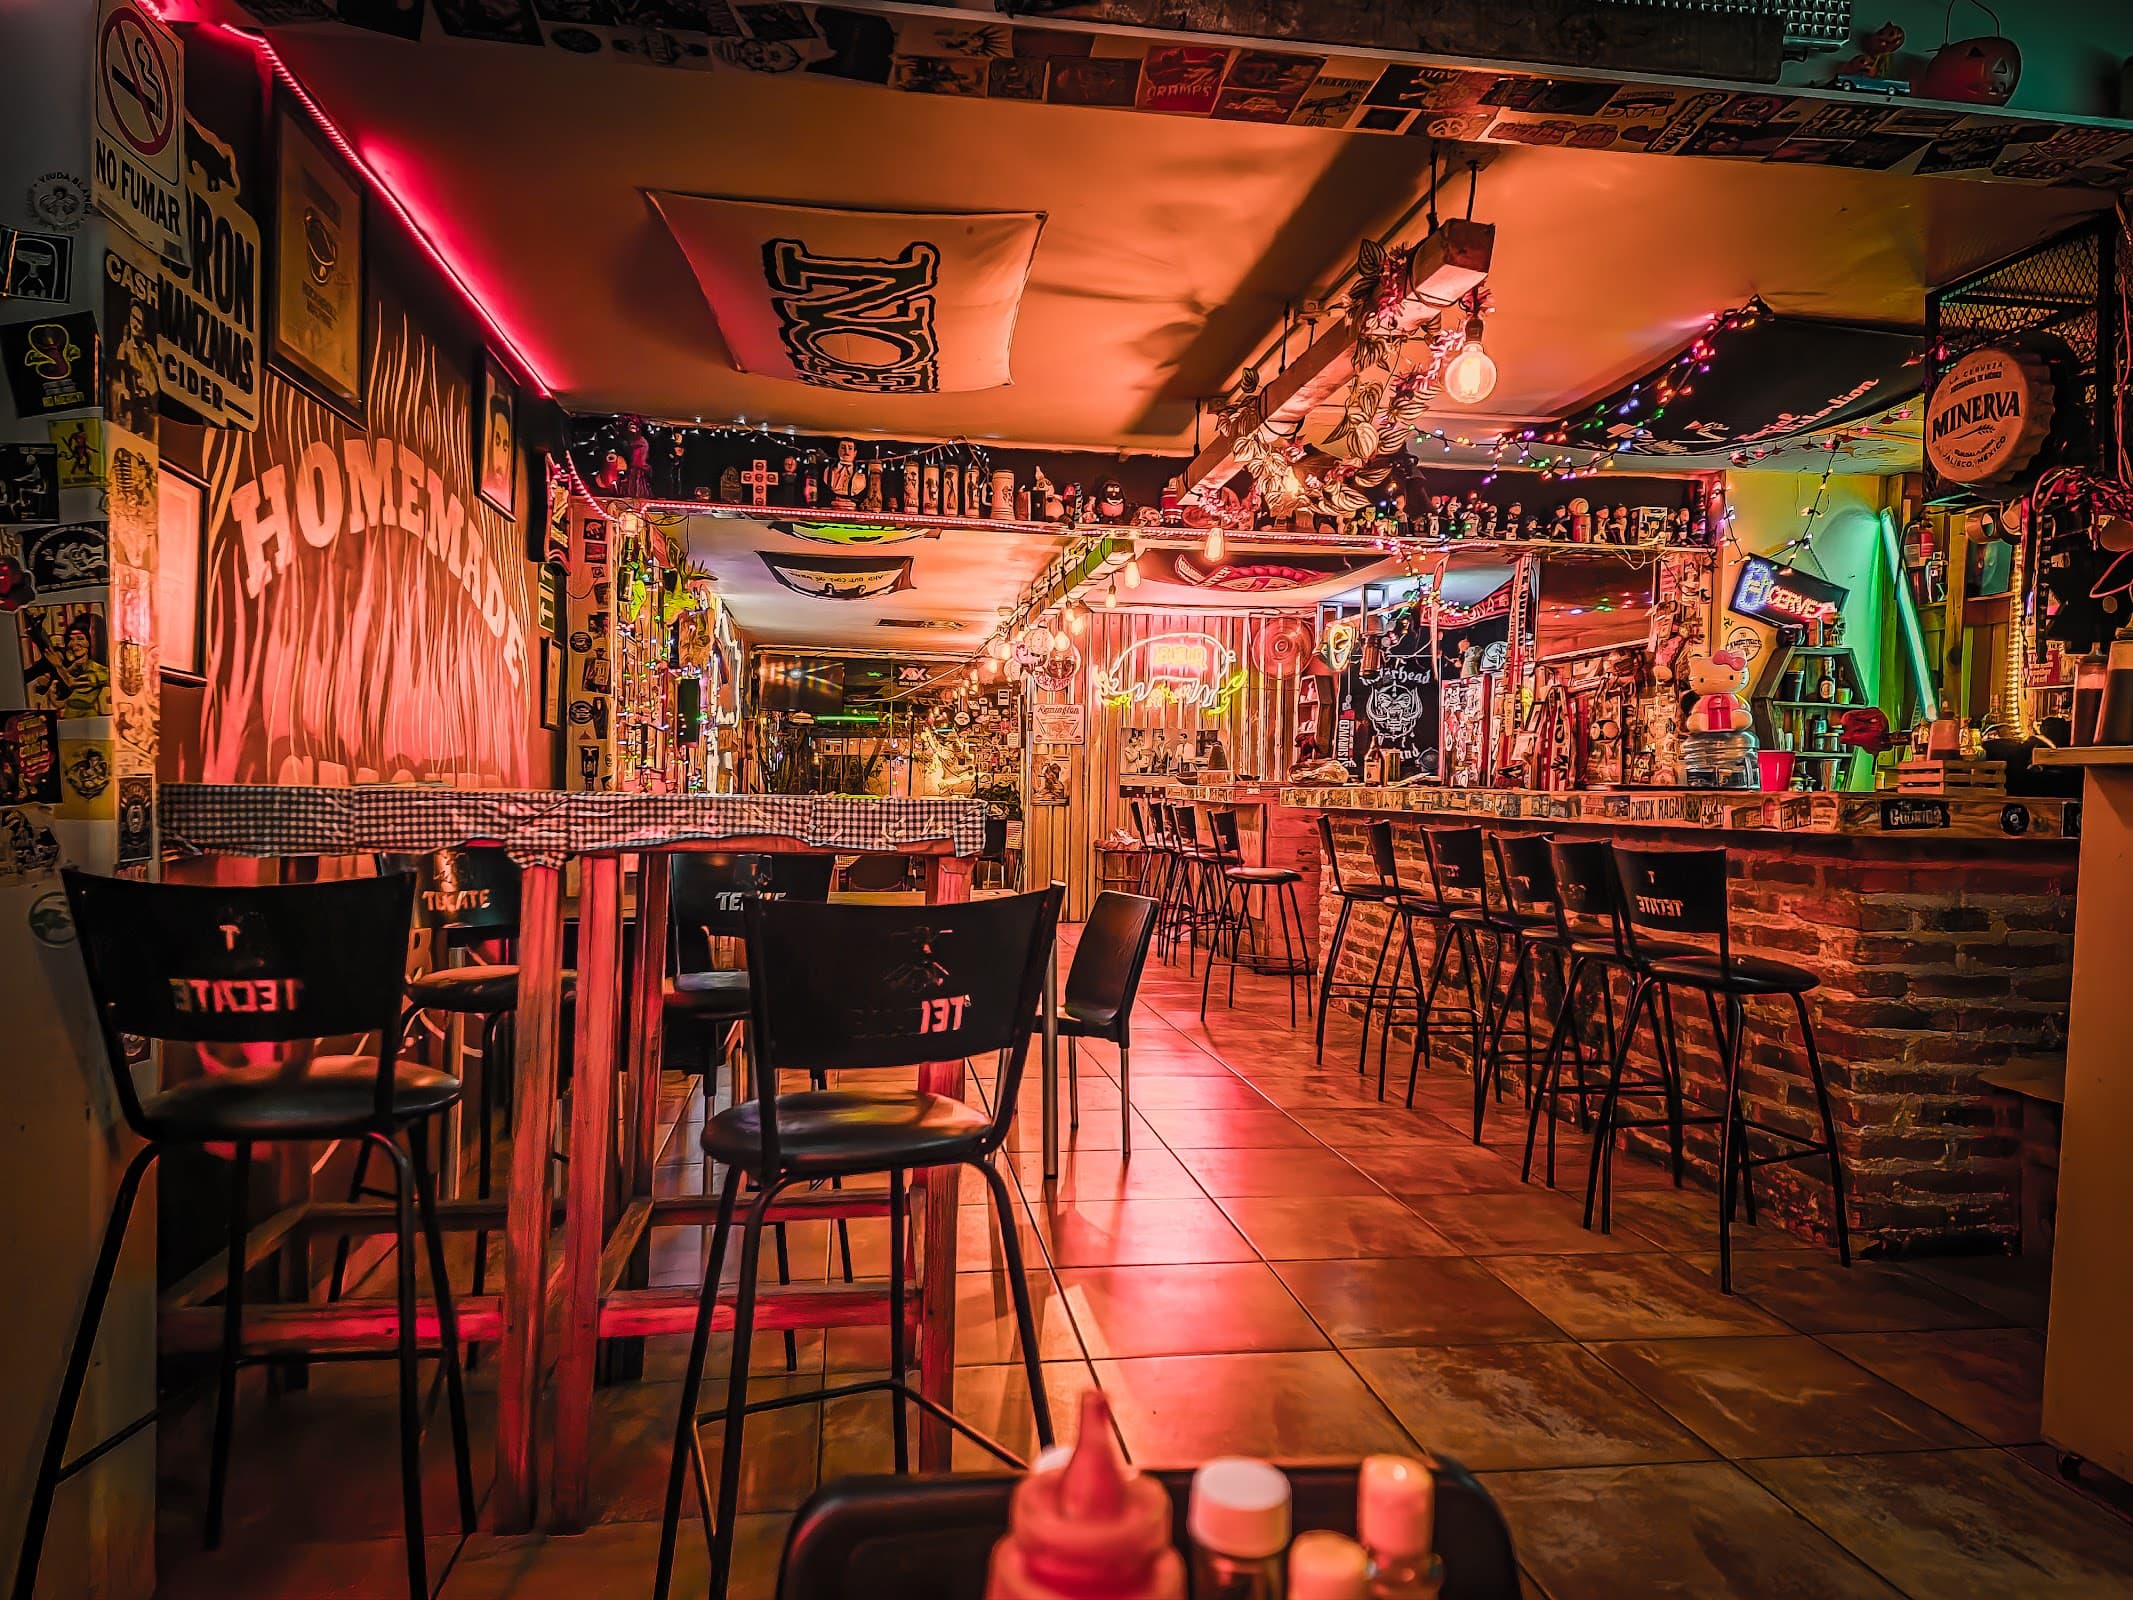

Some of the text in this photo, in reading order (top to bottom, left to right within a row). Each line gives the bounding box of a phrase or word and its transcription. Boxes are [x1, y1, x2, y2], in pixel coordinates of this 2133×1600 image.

[95, 137, 182, 237] NO FUMAR
[105, 253, 159, 311] CASH
[163, 353, 223, 412] CIDER
[1963, 361, 2004, 378] CERVEZA
[1931, 391, 2021, 443] MINERVA
[231, 438, 525, 688] HOMEMADE
[1037, 704, 1080, 716] Remington
[1337, 719, 1350, 757] SURVIVED
[1630, 797, 1686, 821] CHUCK RAGAN
[421, 888, 491, 912] TECATE
